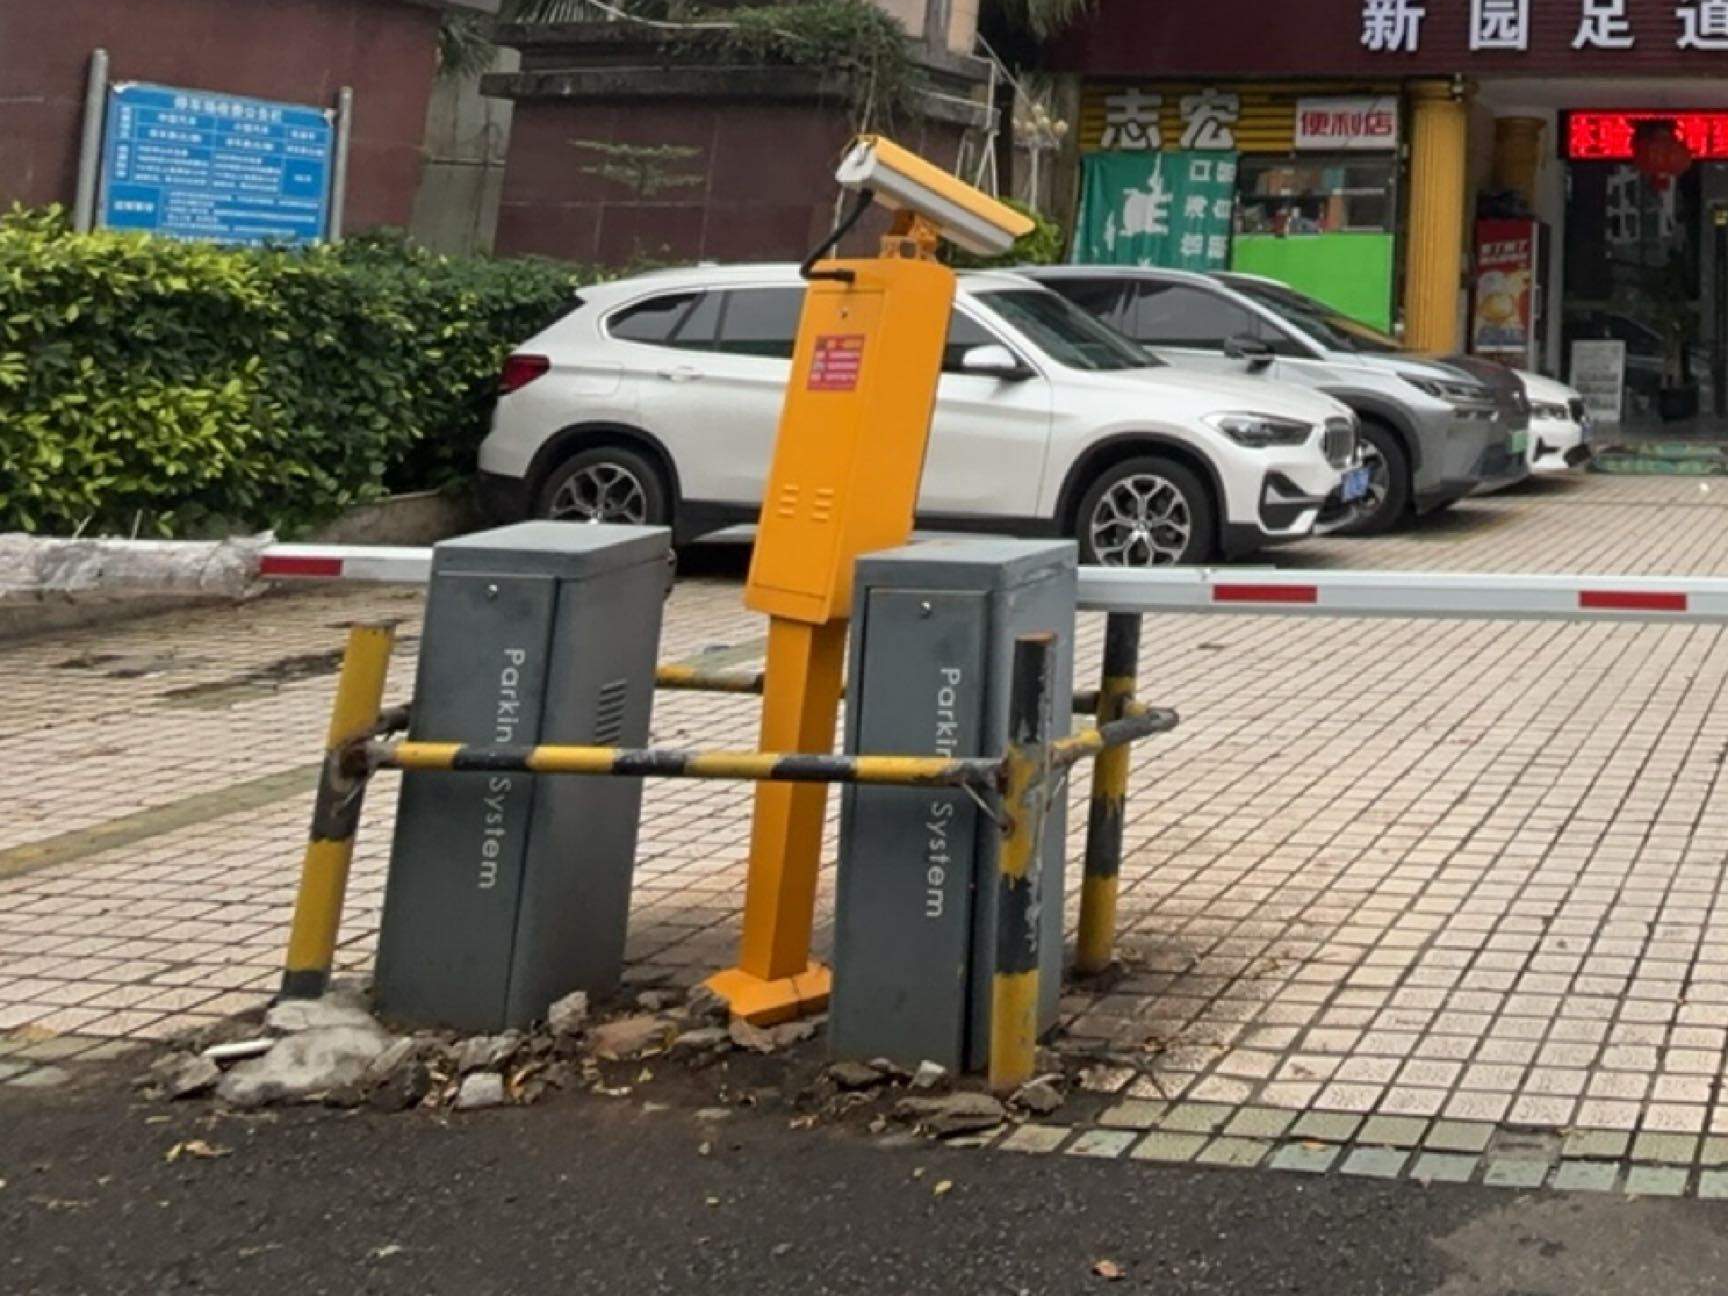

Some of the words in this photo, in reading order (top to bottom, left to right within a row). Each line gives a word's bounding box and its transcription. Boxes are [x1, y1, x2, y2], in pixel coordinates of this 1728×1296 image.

[1301, 110, 1394, 137] 便利店
[496, 647, 526, 746] Parkin
[477, 776, 512, 889] System
[924, 800, 953, 917] System
